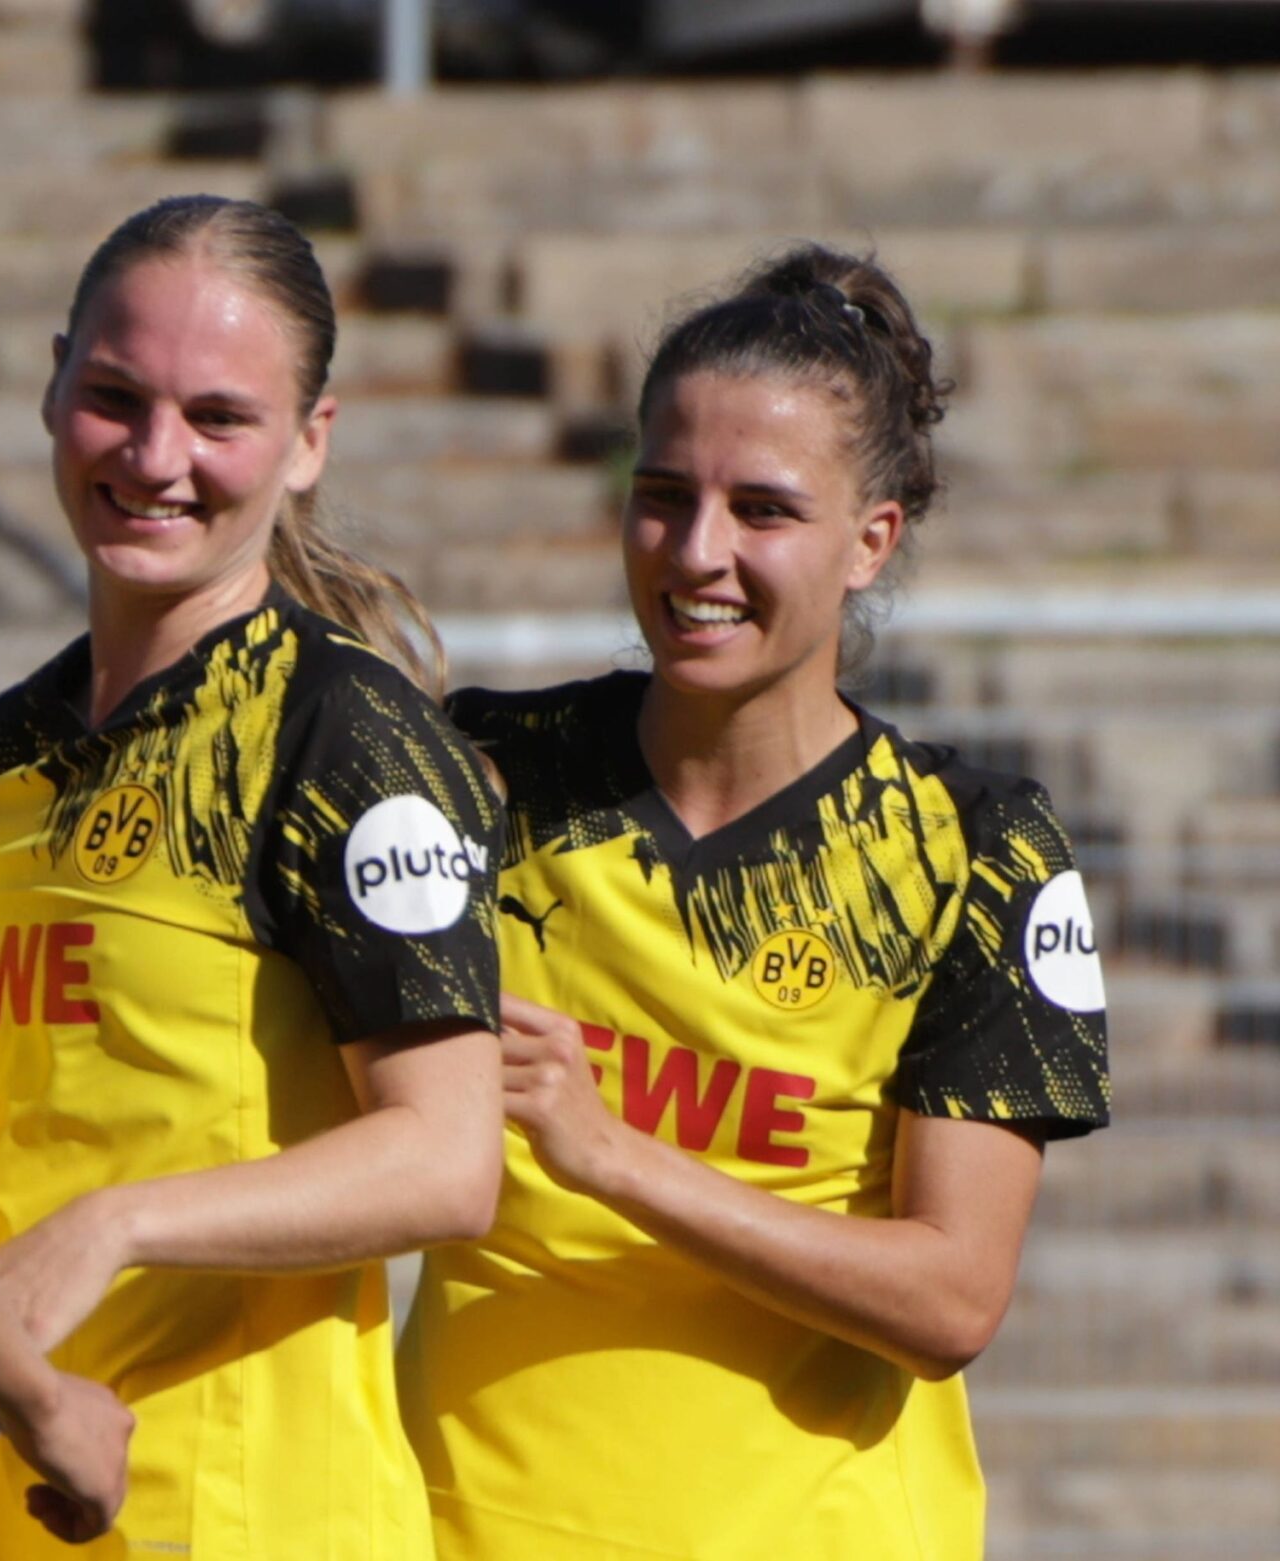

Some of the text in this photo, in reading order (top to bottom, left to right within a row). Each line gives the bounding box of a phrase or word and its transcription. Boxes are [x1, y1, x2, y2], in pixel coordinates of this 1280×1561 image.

[85, 793, 153, 857] BVB
[93, 854, 118, 876] 09
[762, 937, 827, 989] BVB
[778, 985, 801, 1003] 09
